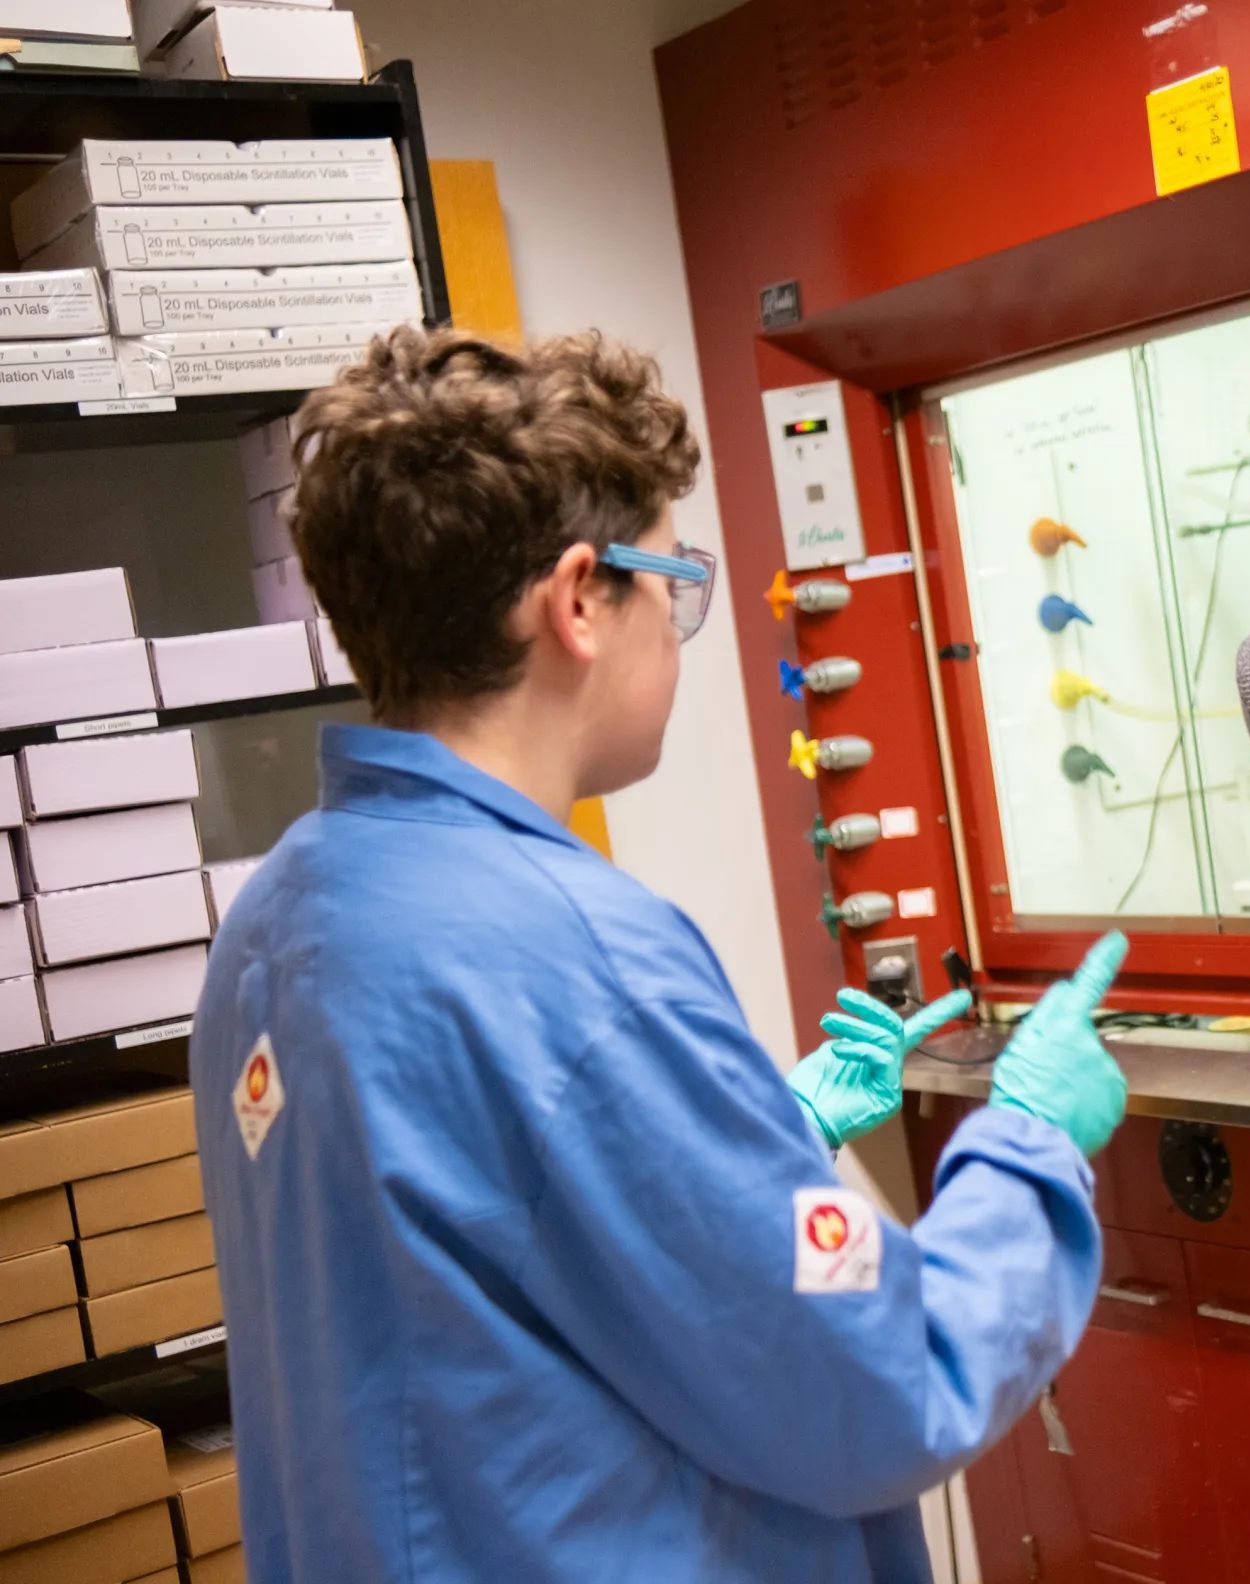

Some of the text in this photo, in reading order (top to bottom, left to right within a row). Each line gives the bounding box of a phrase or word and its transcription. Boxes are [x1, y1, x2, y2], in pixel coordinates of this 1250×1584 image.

[141, 170, 156, 182] 20
[160, 170, 179, 182] mL
[182, 169, 248, 183] Disposable
[250, 168, 317, 181] Scintillation
[319, 168, 348, 179] Vials
[147, 237, 162, 249] 20
[166, 237, 186, 248] mL
[189, 236, 254, 250] Disposable
[258, 233, 323, 246] Scintillation
[325, 231, 354, 243] Vials
[164, 299, 181, 311] 20
[184, 298, 204, 310] mL
[208, 298, 275, 312] Disposable
[279, 294, 343, 308] Scintillation
[345, 293, 373, 304] Vials
[14, 303, 49, 315] Vials
[174, 362, 190, 374] 20
[193, 361, 213, 373] mL
[215, 355, 281, 371] Disposable
[285, 352, 351, 368] Scintillation
[42, 369, 74, 381] Vials
[131, 401, 150, 411] Vials
[84, 723, 106, 733] Short
[142, 1031, 163, 1042] Long
